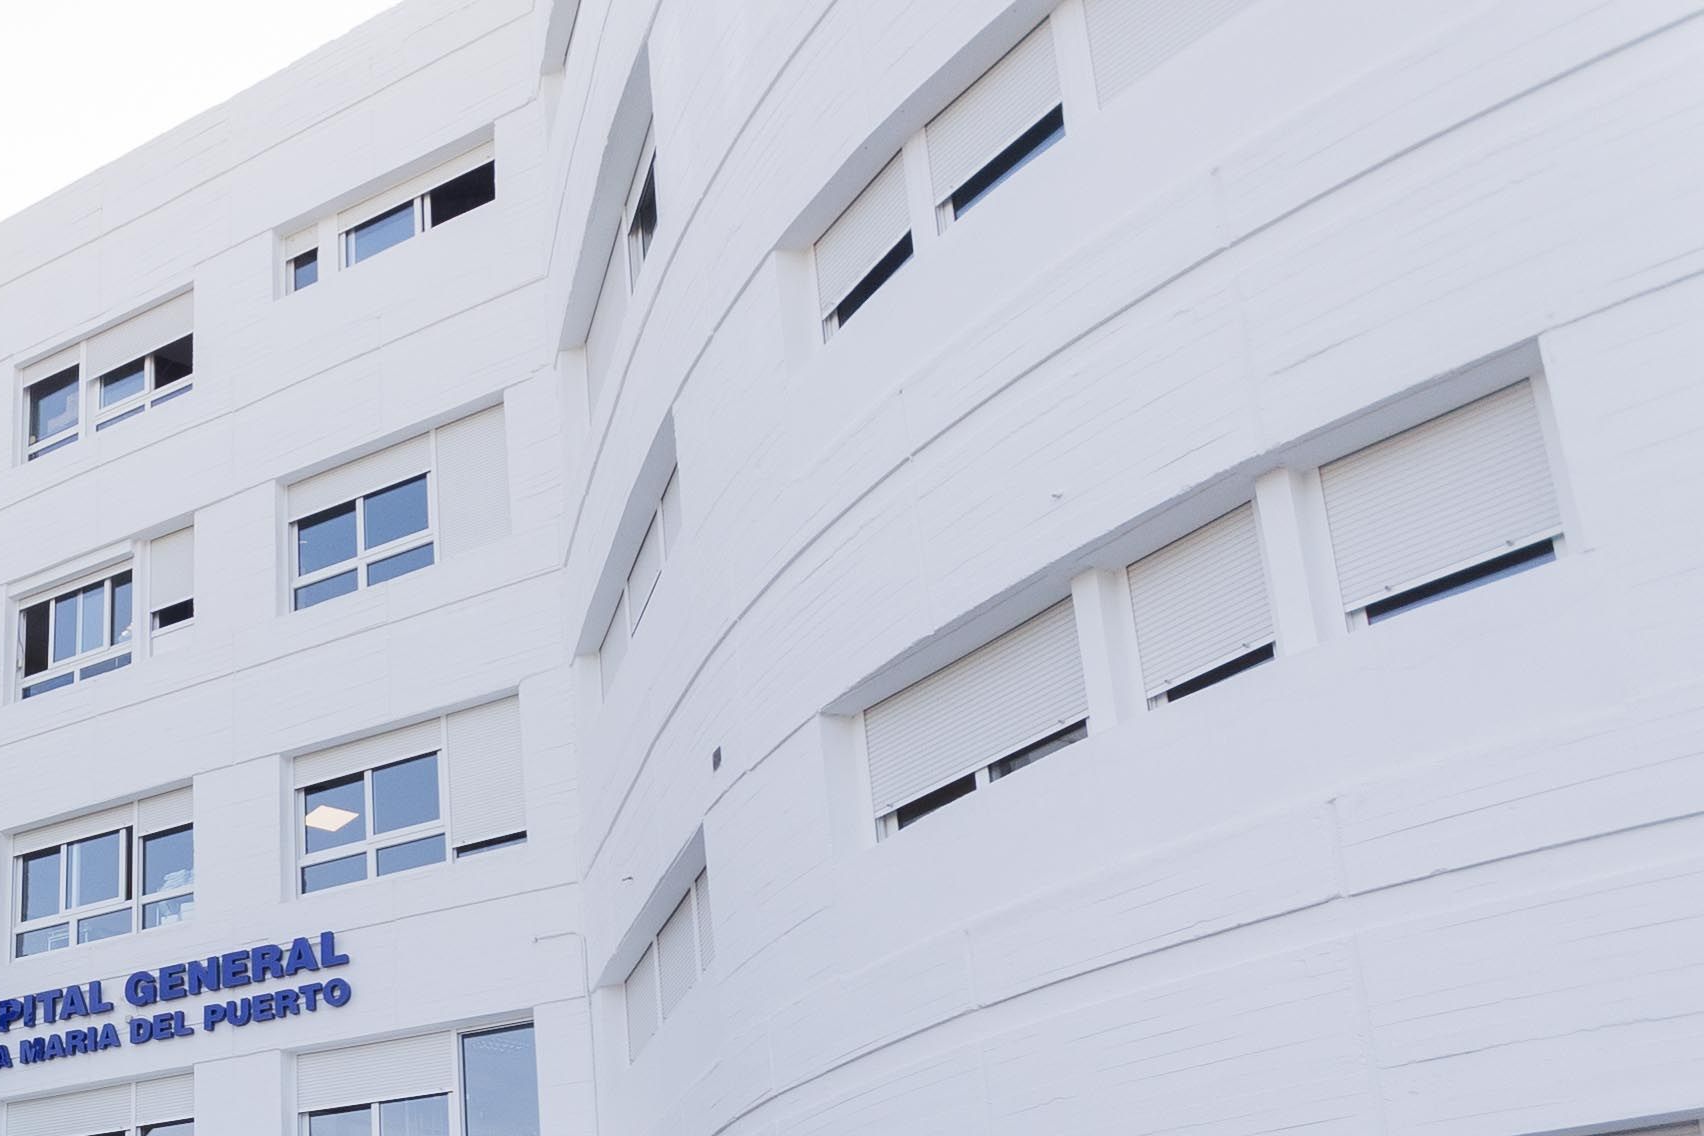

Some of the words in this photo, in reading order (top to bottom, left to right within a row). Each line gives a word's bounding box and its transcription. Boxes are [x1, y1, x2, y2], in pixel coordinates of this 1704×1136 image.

[125, 931, 350, 1007] GENERAL
[20, 1023, 121, 1064] MARIA
[129, 1010, 195, 1045] DEL
[203, 977, 352, 1032] PUERTO
